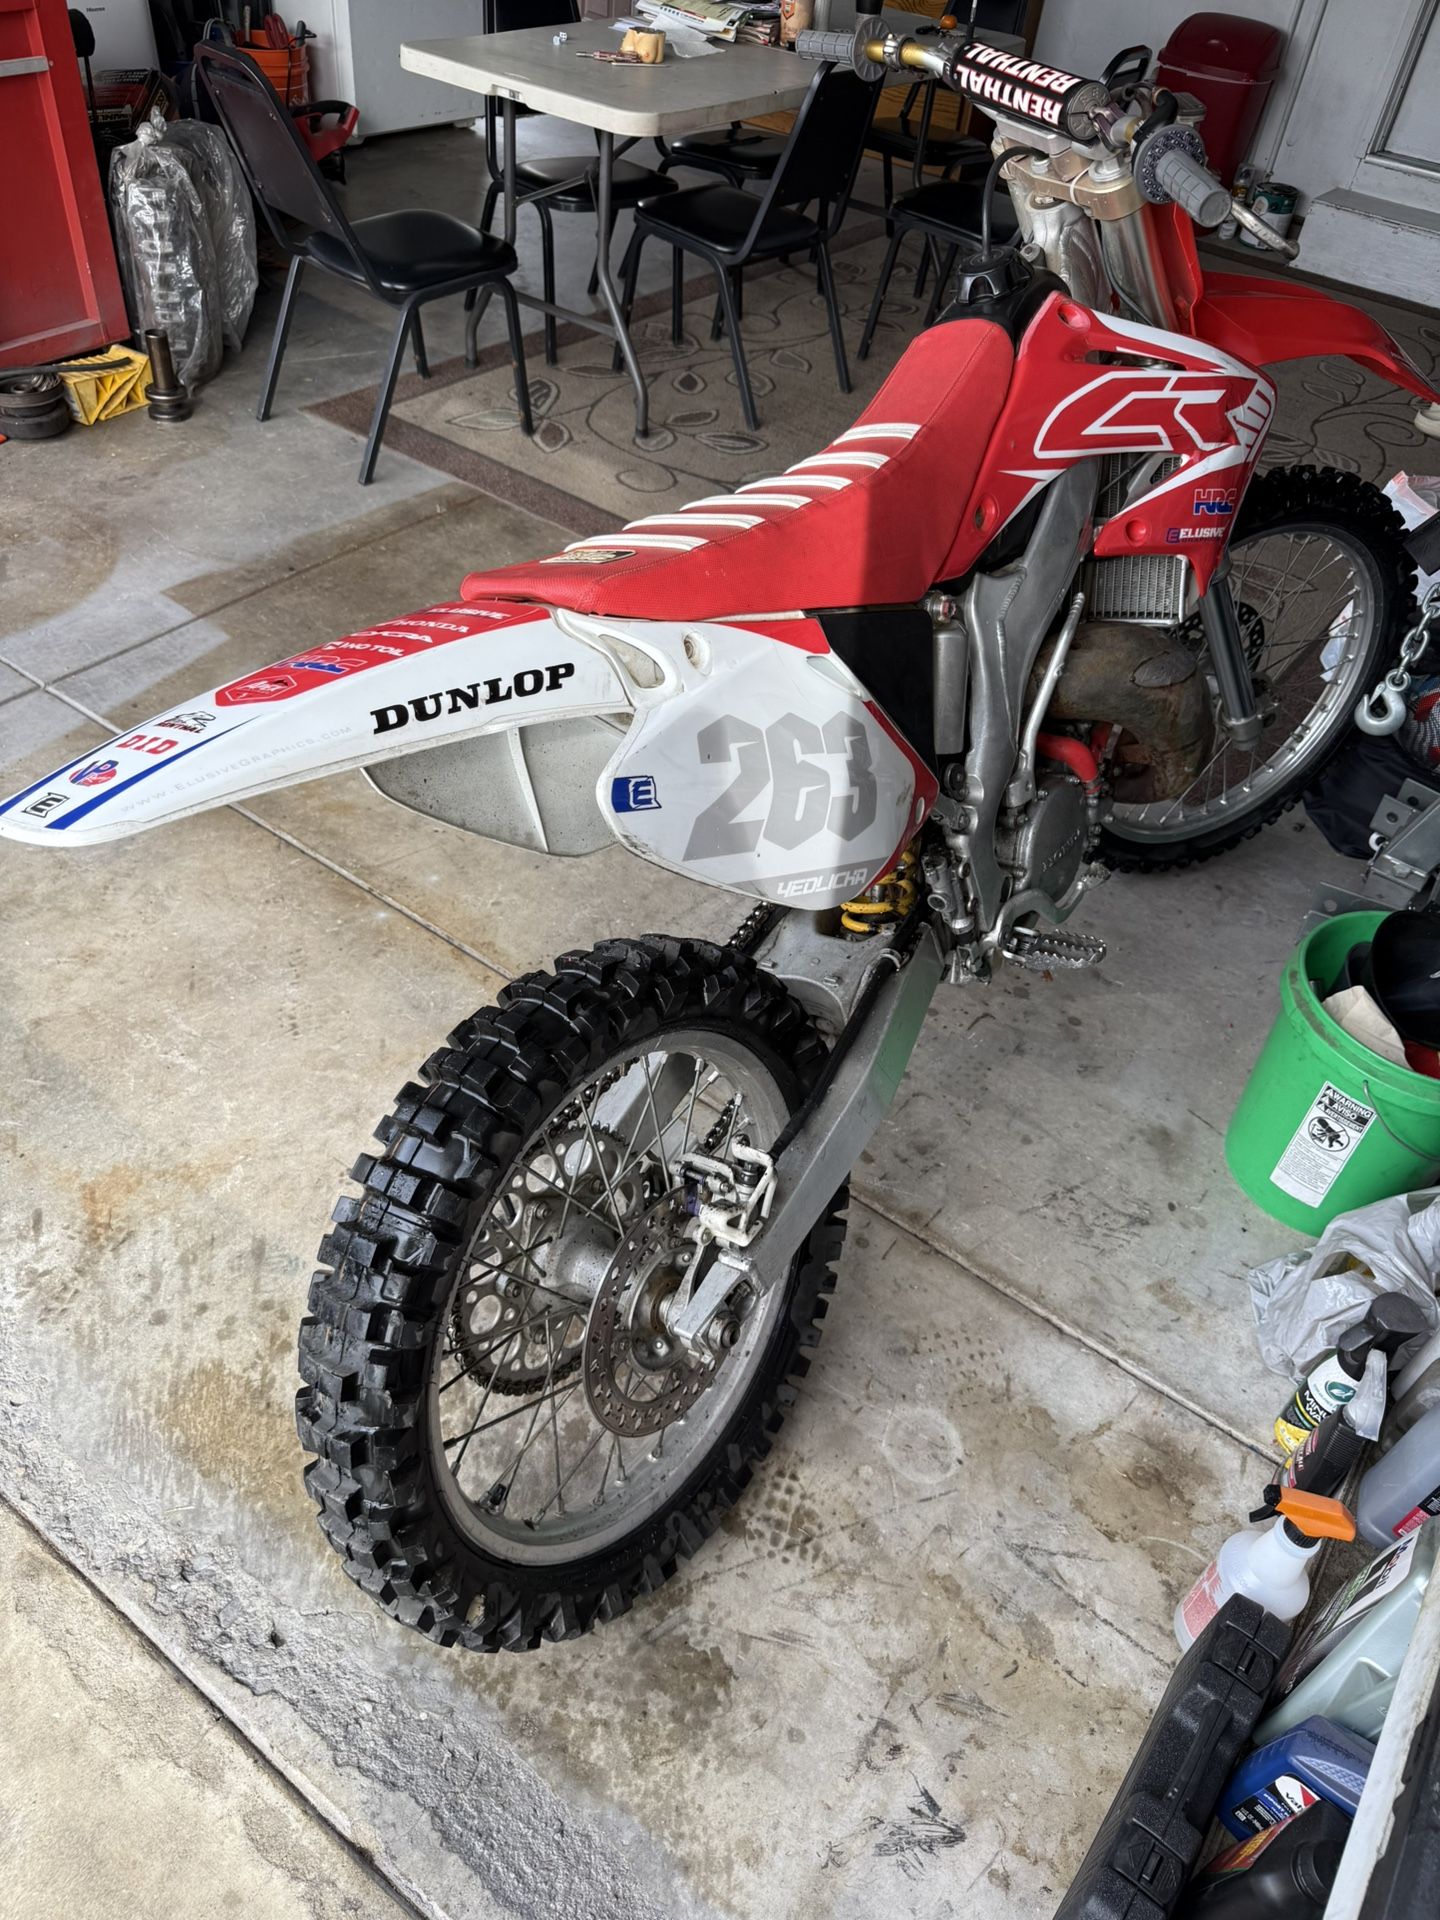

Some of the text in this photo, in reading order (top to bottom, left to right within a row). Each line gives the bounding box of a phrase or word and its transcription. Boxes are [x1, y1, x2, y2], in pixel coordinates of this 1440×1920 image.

[964, 42, 1082, 94] RENTHAL
[956, 64, 1063, 126] RENTHAL
[1193, 488, 1237, 516] HRC
[1179, 526, 1226, 540] ELUSIVE
[391, 618, 470, 634] HONDA
[370, 663, 575, 734] DUNLOP
[682, 711, 877, 861] 263
[1331, 1090, 1372, 1118] WARNING
[1332, 1102, 1358, 1120] AVISO
